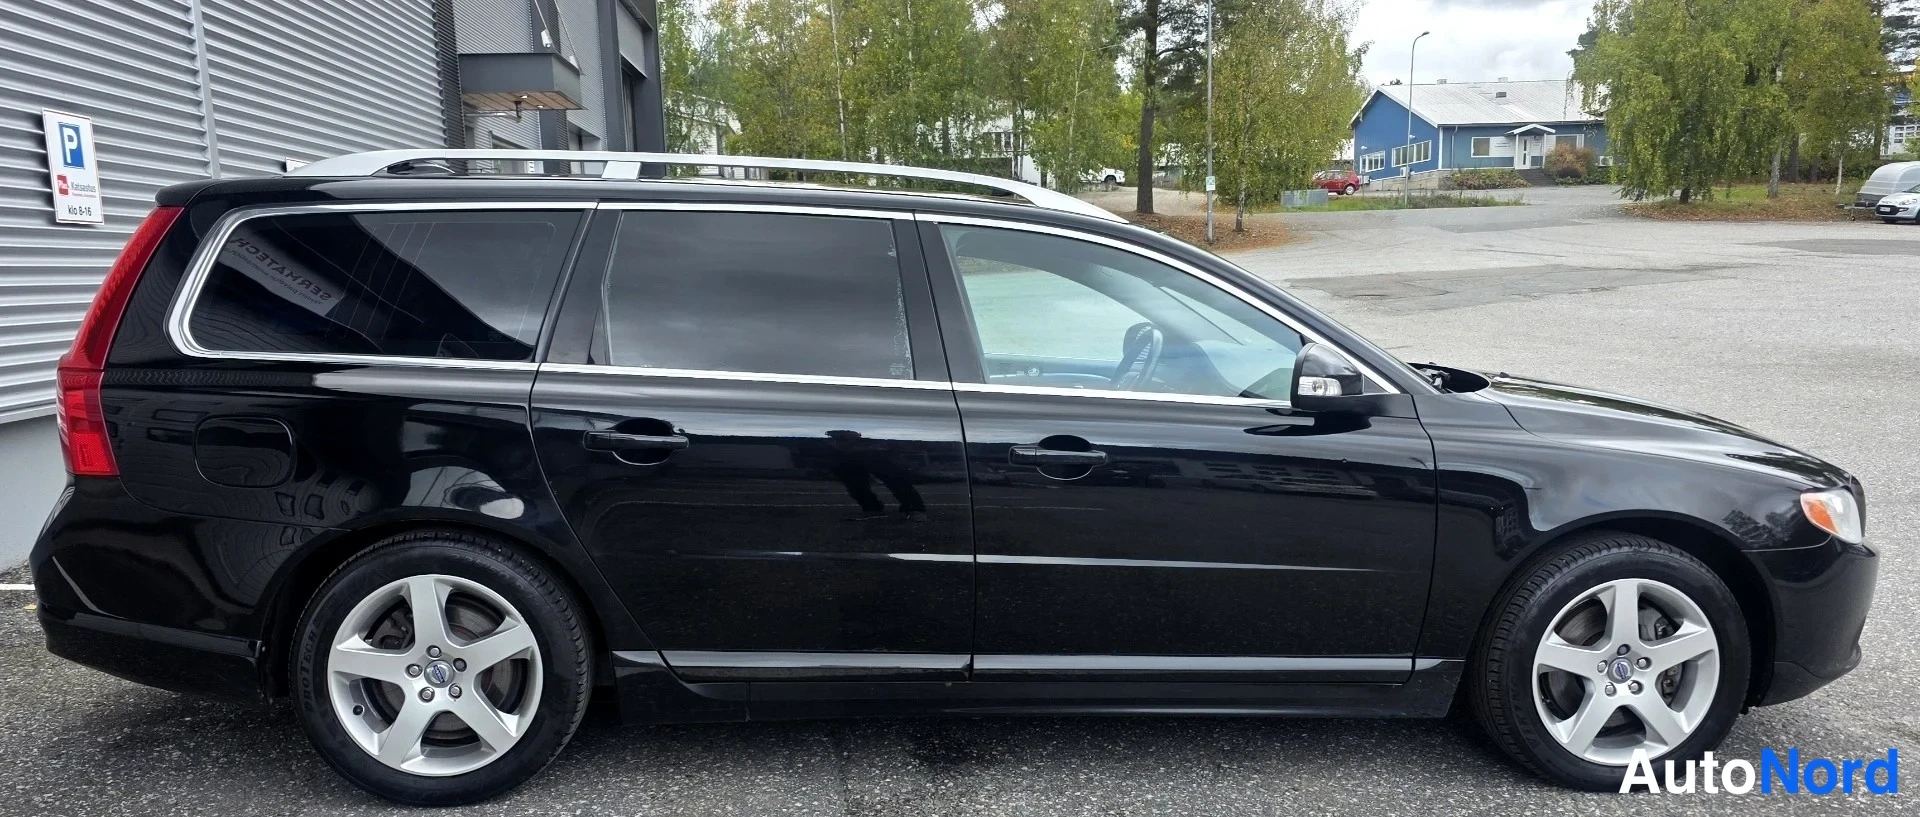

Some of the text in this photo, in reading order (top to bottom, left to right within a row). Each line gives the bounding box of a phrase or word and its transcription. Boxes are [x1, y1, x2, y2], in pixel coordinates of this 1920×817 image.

[62, 126, 78, 164] P
[68, 205, 92, 216] klo 8-16
